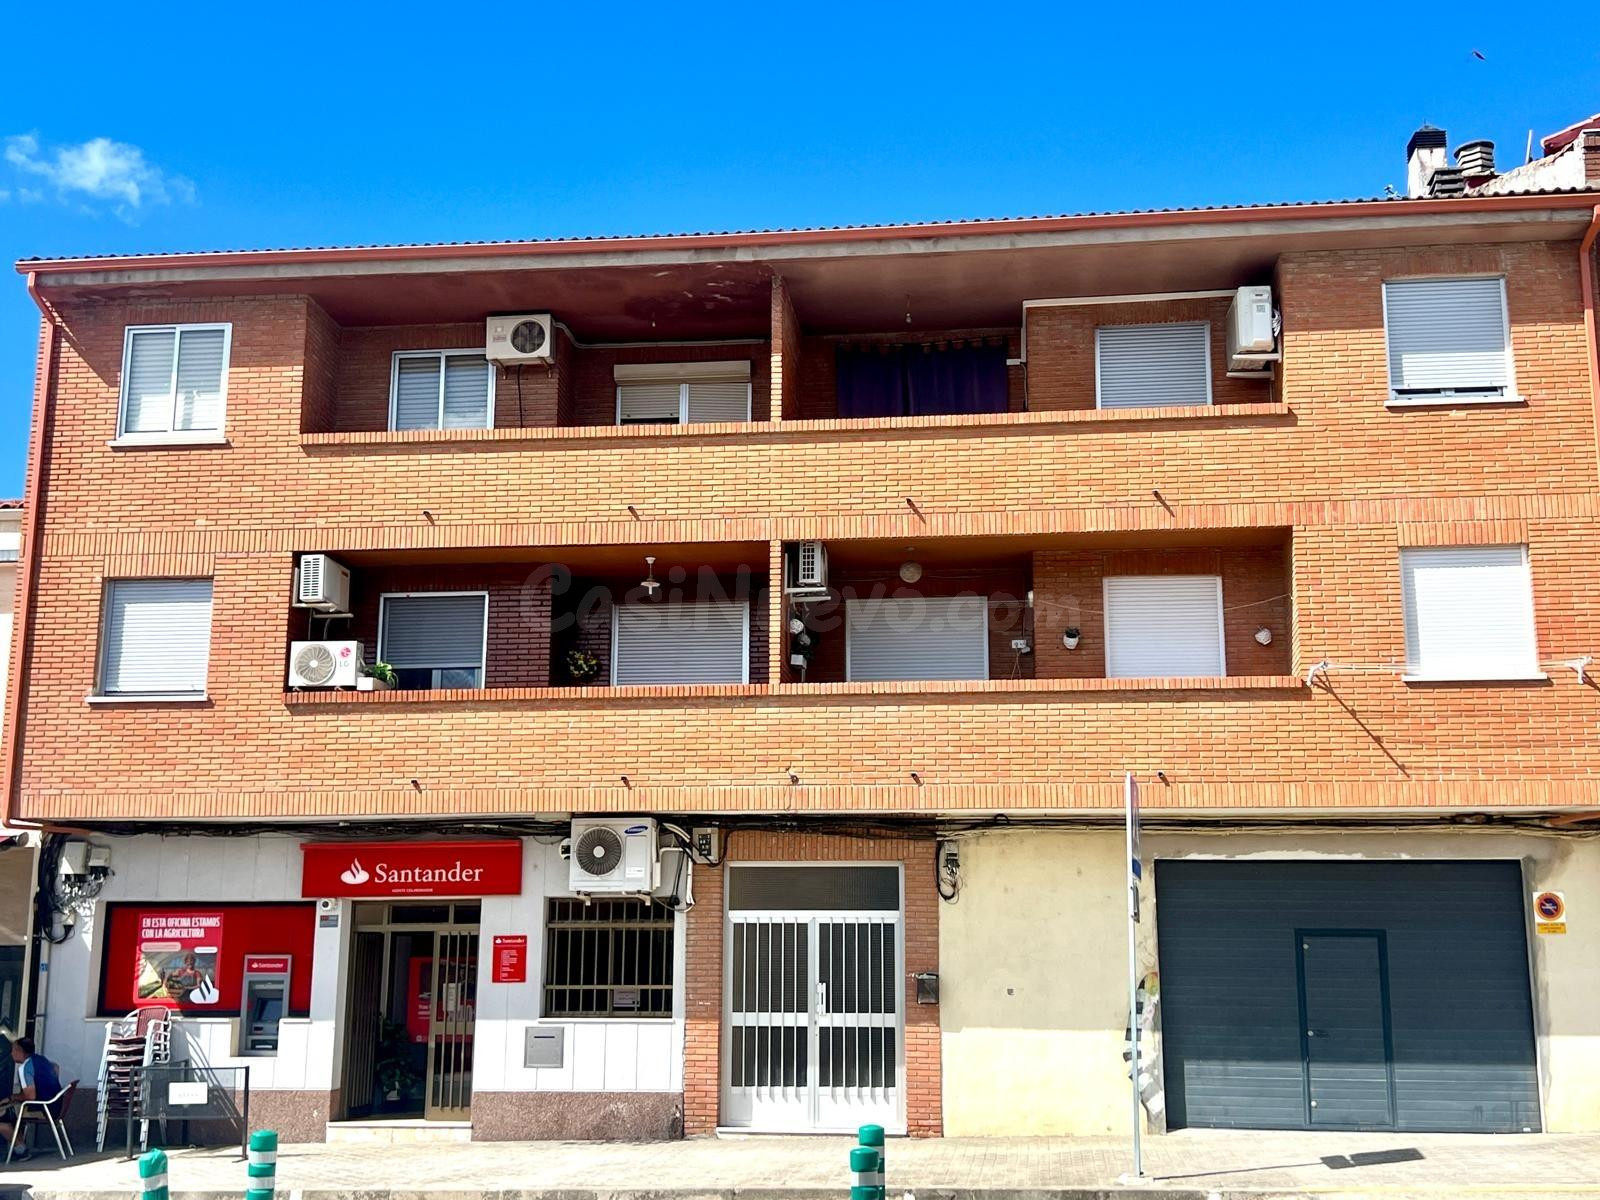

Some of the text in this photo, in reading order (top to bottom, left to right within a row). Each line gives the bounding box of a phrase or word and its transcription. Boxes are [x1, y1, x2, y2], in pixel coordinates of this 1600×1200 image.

[340, 660, 350, 668] LG
[374, 861, 484, 884] Santander
[142, 916, 221, 928] EN ESTA OFICINA ESTAMOS
[141, 928, 205, 938] CON LA AGRICULTURA
